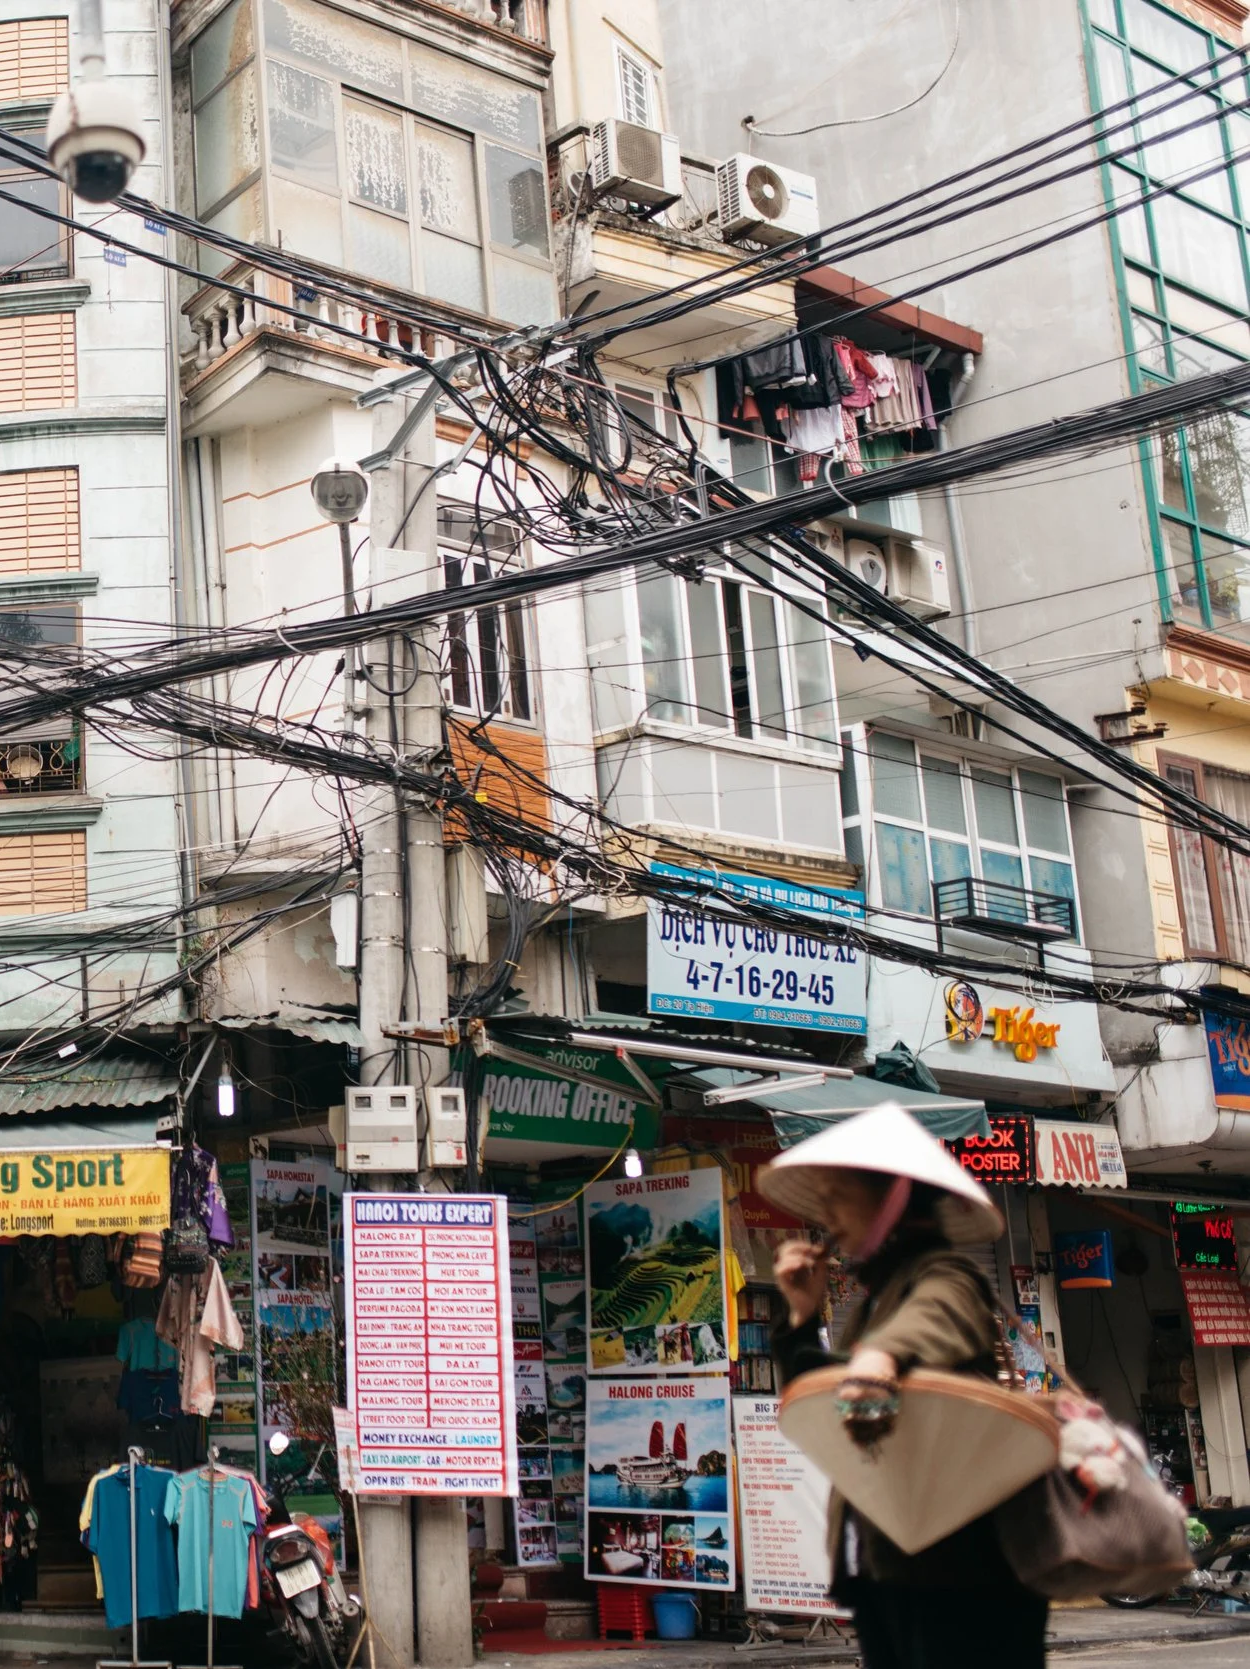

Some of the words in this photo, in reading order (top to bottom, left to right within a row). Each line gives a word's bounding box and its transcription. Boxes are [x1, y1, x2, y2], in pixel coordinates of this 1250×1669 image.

[661, 908, 706, 952] DỊCH
[686, 959, 834, 1006] 4-7-16-29-45
[989, 1006, 1061, 1063] Tiger
[1209, 1019, 1250, 1077] Tig
[546, 1049, 601, 1071] advisor
[482, 1074, 570, 1119] BOOKING
[571, 1081, 637, 1125] OFFICE
[964, 1129, 1015, 1149] BOOK
[960, 1152, 1021, 1172] POSTER
[1051, 1130, 1101, 1183] ANH
[32, 1153, 125, 1192] Sport
[267, 1169, 283, 1180] SAPA
[284, 1171, 315, 1182] HOMESTAY
[615, 1181, 643, 1196] SAPA
[645, 1176, 690, 1194] TREKING
[356, 1202, 399, 1221] HANOI
[400, 1203, 443, 1222] TOURS
[445, 1203, 491, 1224] EXPERT
[10, 1213, 54, 1233] Longsport
[360, 1232, 397, 1240] HALONG
[399, 1232, 416, 1240] BAY
[359, 1250, 379, 1258] SAPA
[381, 1250, 418, 1258] TREKKING
[1060, 1242, 1104, 1269] Tiger
[452, 1287, 463, 1295] AN
[466, 1287, 488, 1295] TOUR
[278, 1294, 292, 1304] SAPA
[413, 1323, 423, 1331] AN
[448, 1324, 471, 1332] TRANG
[474, 1324, 494, 1332] TOUR
[454, 1342, 464, 1350] NE
[466, 1342, 486, 1350] TOUR
[358, 1360, 384, 1368] HANOI
[386, 1360, 402, 1368] CITY
[404, 1360, 424, 1368] TOUR
[360, 1379, 370, 1387] HA
[374, 1379, 400, 1387] GIANG
[402, 1379, 423, 1387] TOUR
[450, 1379, 469, 1387] GON
[471, 1379, 493, 1387] TOUR
[609, 1385, 653, 1399] HALONG
[656, 1384, 696, 1399] CRUISE
[362, 1397, 399, 1405] WALKING
[402, 1397, 423, 1405] TOUR
[434, 1398, 469, 1406] MEKONG
[471, 1398, 496, 1406] DELTA
[754, 1403, 770, 1413] BIG
[363, 1415, 385, 1423] STREET
[386, 1415, 405, 1423] FOOD
[407, 1415, 425, 1423] TOUR
[363, 1434, 396, 1444] MONEY
[399, 1434, 448, 1444] EXCHANGE
[455, 1434, 498, 1444] LAUNDRY
[363, 1455, 379, 1465] TAXI
[380, 1455, 390, 1465] TO
[391, 1455, 421, 1465] AIRPORT
[426, 1455, 441, 1465] CAR
[446, 1455, 472, 1465] MOTOR
[473, 1455, 500, 1465] RENTAL
[364, 1476, 388, 1487] OPEN
[390, 1476, 405, 1487] BUS
[412, 1476, 438, 1487] TRAIN
[470, 1476, 499, 1487] TICKET
